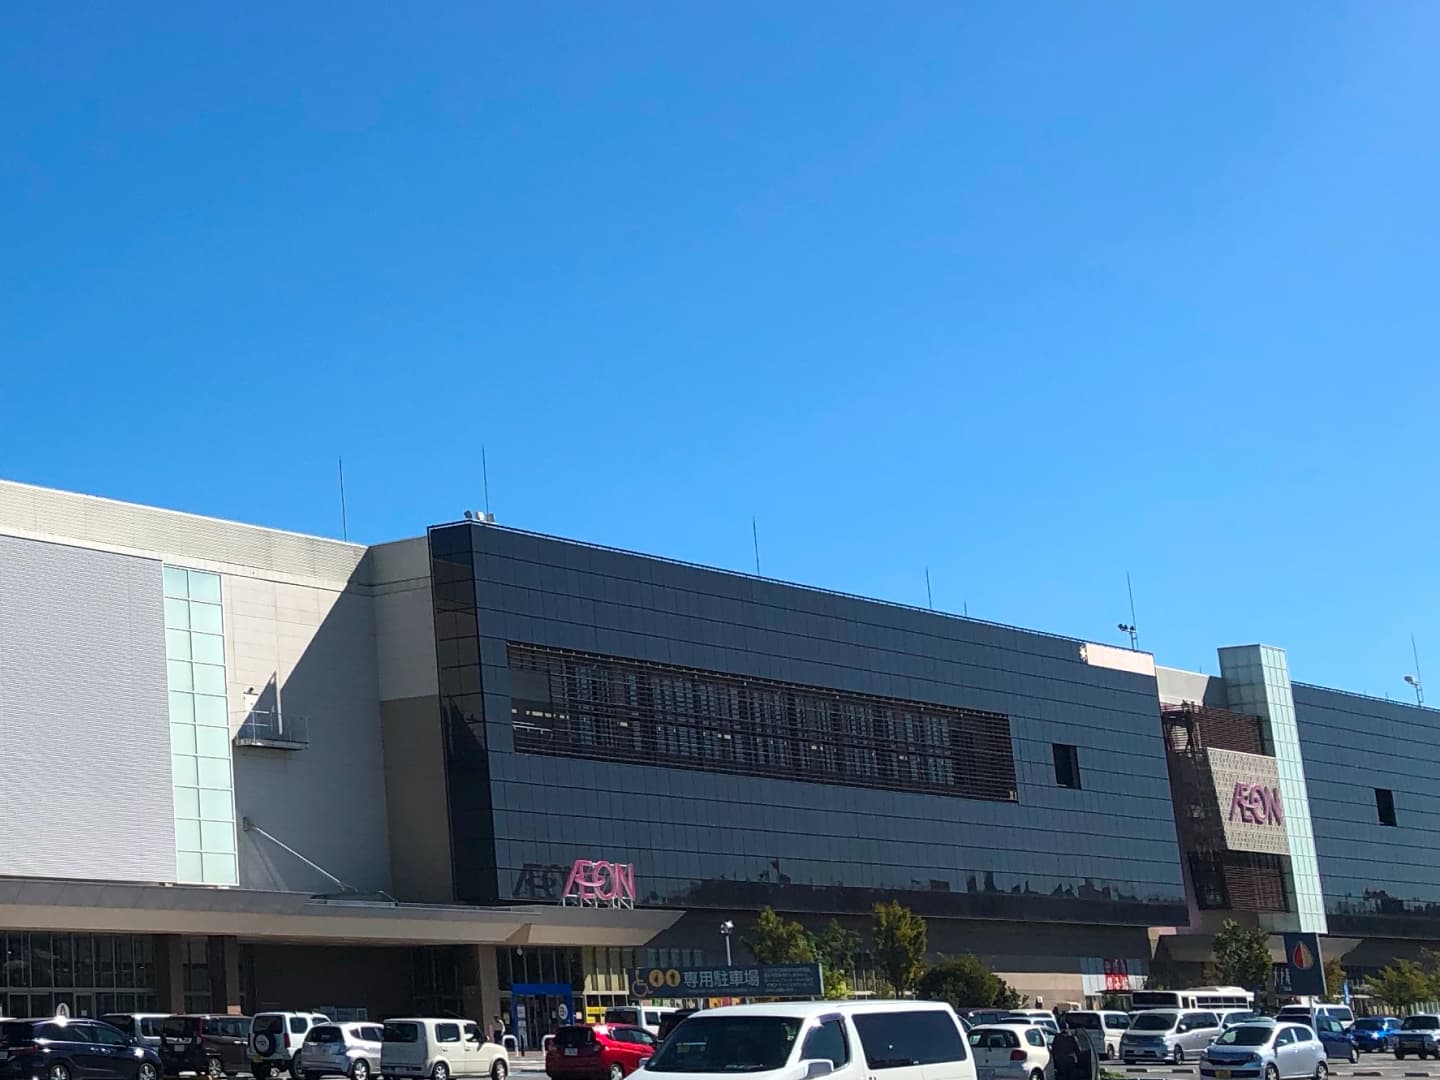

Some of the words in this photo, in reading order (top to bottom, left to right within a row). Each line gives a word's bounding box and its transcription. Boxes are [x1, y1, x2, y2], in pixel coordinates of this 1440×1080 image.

[683, 969, 760, 988] 専用駐車場
